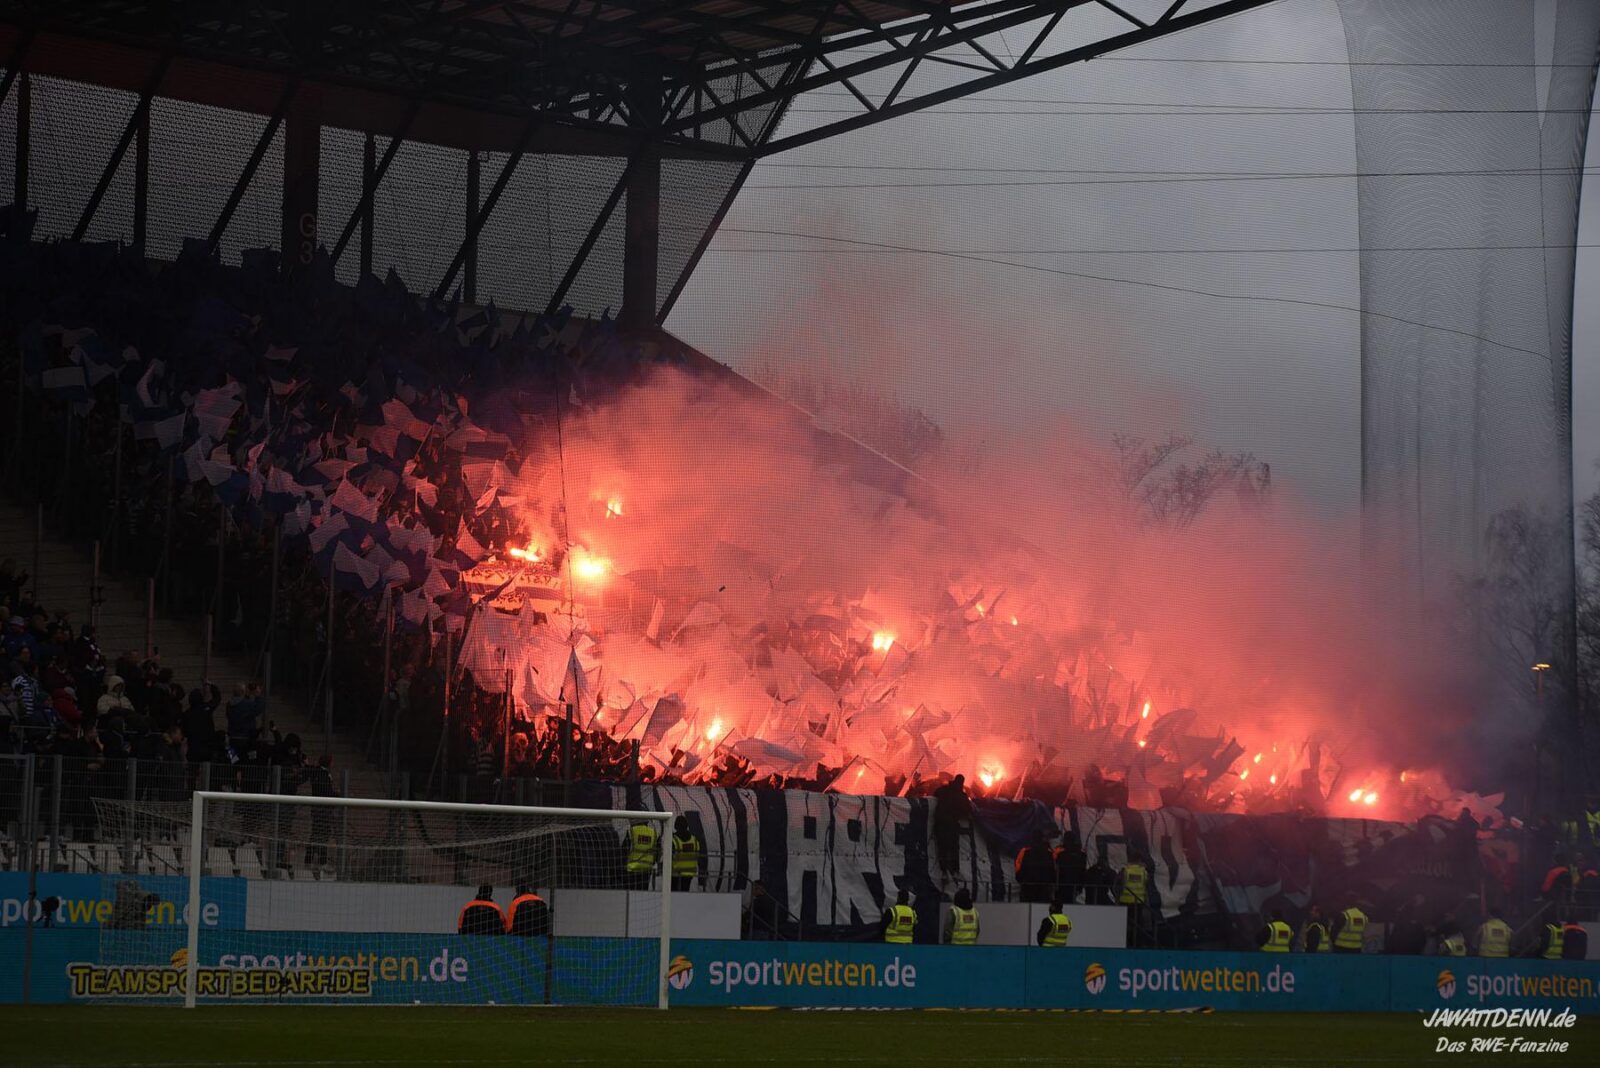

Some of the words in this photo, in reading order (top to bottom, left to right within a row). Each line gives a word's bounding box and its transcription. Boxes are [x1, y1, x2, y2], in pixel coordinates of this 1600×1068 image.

[709, 956, 917, 993] sportwetten.de
[1118, 964, 1295, 998] sportwetten.de
[1466, 972, 1600, 1002] sportwetten.
